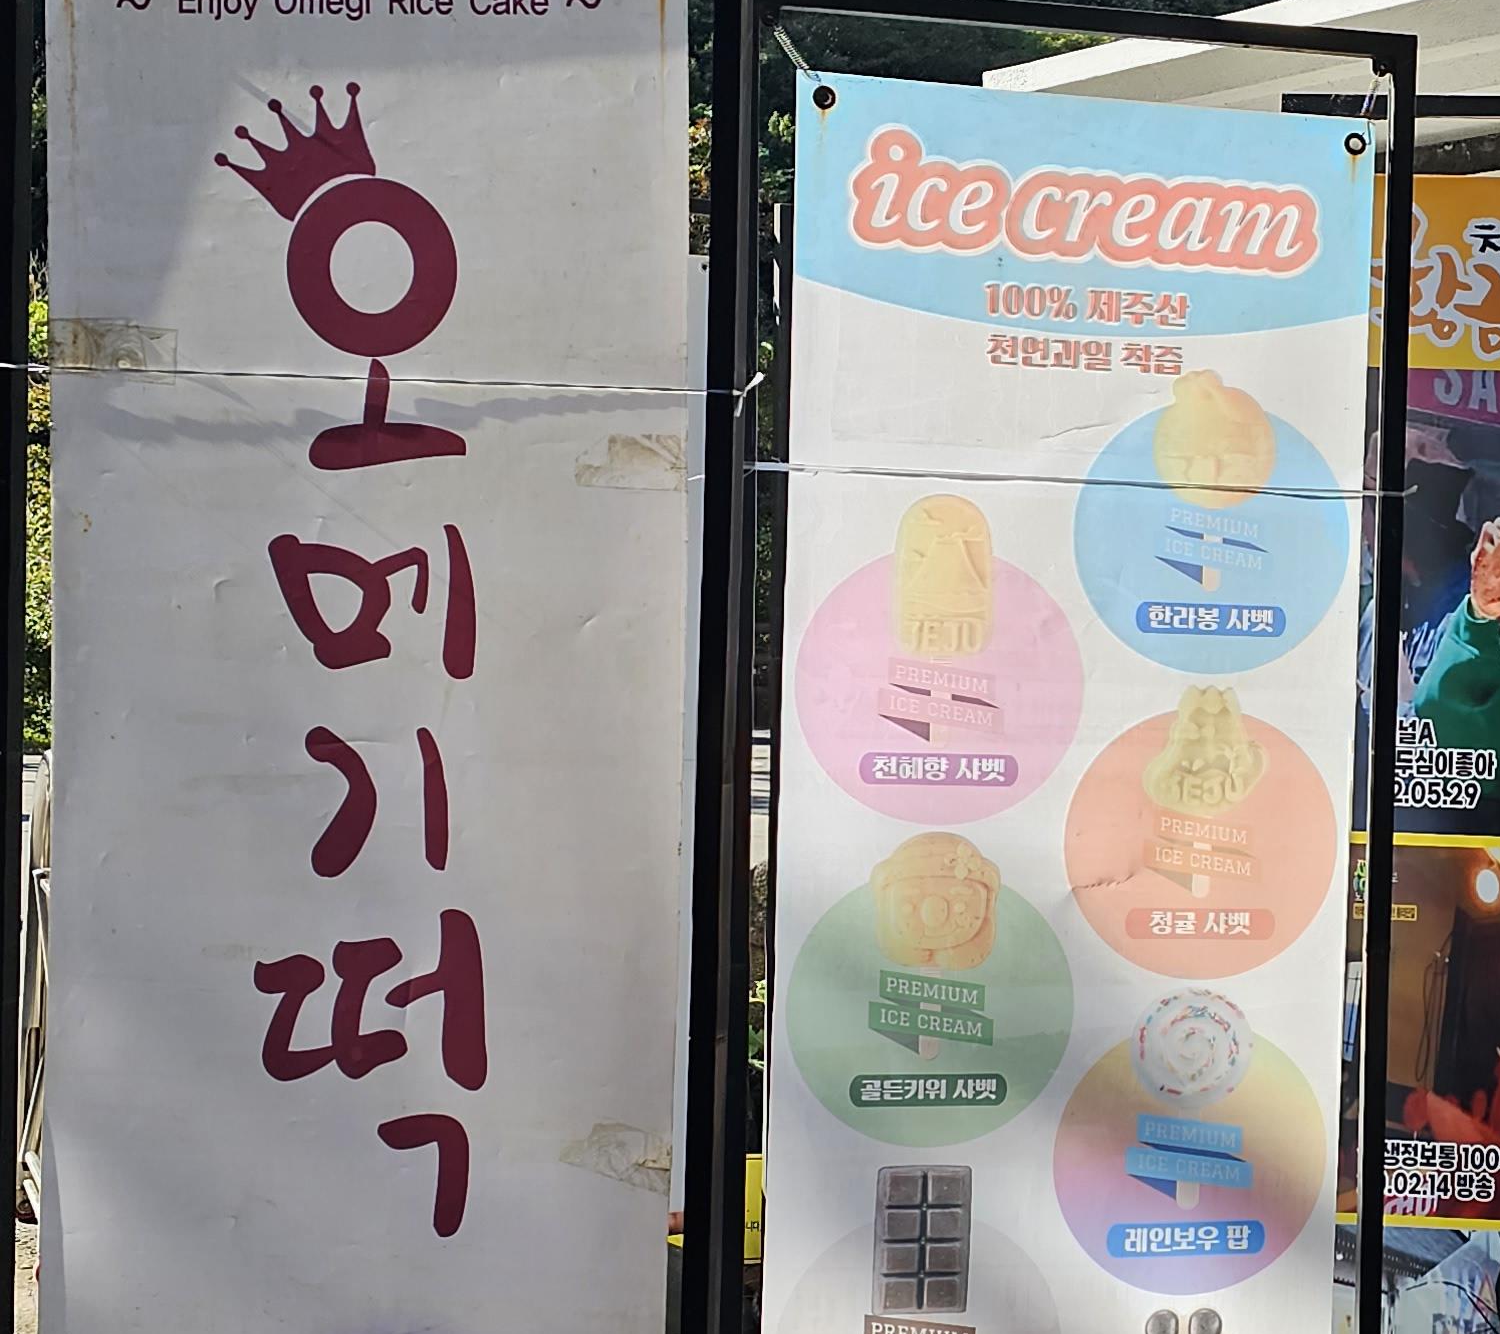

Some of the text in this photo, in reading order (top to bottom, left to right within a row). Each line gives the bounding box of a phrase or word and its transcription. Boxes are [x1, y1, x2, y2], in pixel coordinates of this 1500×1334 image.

[860, 133, 1312, 268] ice cream
[985, 282, 1190, 328] 100% 제주산
[1170, 507, 1259, 539] PREMIUM
[1164, 540, 1263, 571] ICE CREAM
[1147, 604, 1275, 634] 한라봉 샤벳
[895, 664, 989, 694] PREMIUM
[254, 177, 487, 1237] 오메기떡
[888, 695, 993, 727] ICE CREAM
[872, 754, 1006, 782] 천혜향 샤벳
[1394, 748, 1496, 778] 두심이좋아
[1394, 780, 1480, 807] 2.05.29
[1160, 817, 1248, 844] PREMIUM
[1154, 847, 1252, 877] ICE CREAM
[1149, 910, 1251, 935] 청귤 샤벳
[886, 976, 978, 1006] PREMIUM
[880, 1008, 983, 1038] ICE CREAM
[860, 1078, 998, 1102] 골든키위 샤벳
[1144, 1121, 1237, 1148] PREMIUM
[1137, 1154, 1242, 1183] ICE CREAM
[1384, 1141, 1457, 1169] 생정보통
[1384, 1170, 1496, 1200] .02.14 방송
[1123, 1225, 1252, 1253] 레인보우 팝
